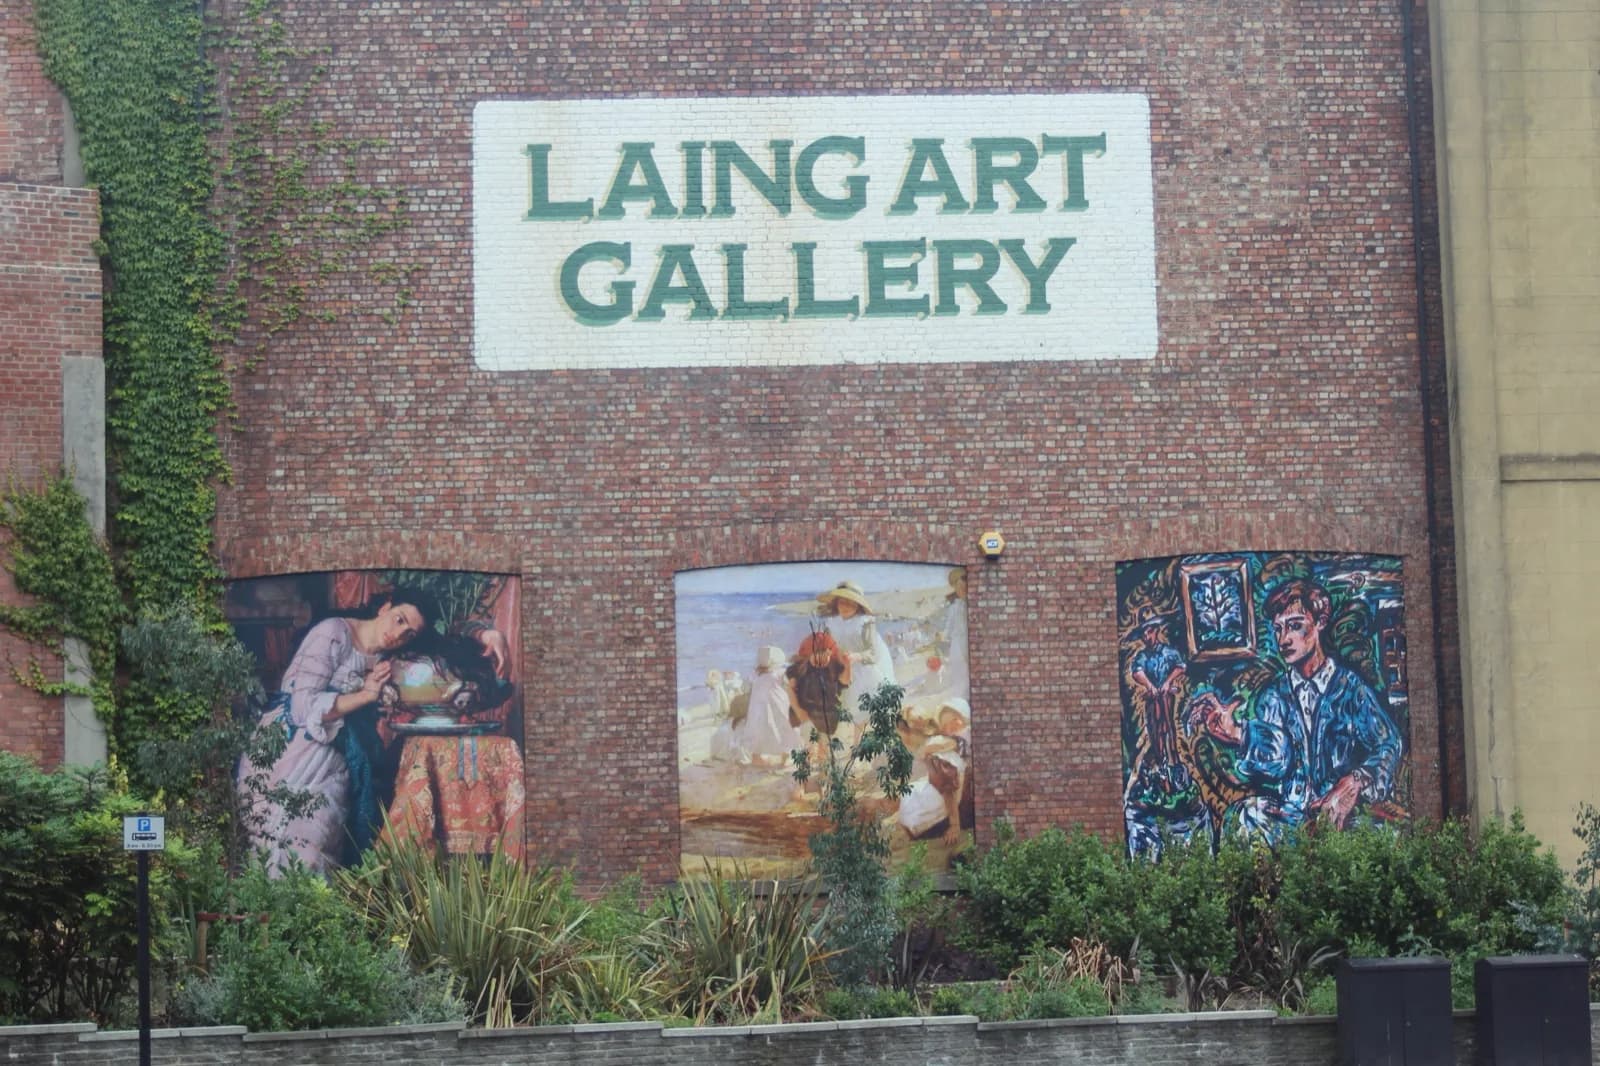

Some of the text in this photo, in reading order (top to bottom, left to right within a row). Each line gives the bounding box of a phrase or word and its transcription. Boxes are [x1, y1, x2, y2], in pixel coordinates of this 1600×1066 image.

[522, 132, 1107, 221] LAING ART
[557, 237, 1077, 326] GALLERY
[141, 820, 149, 830] P
